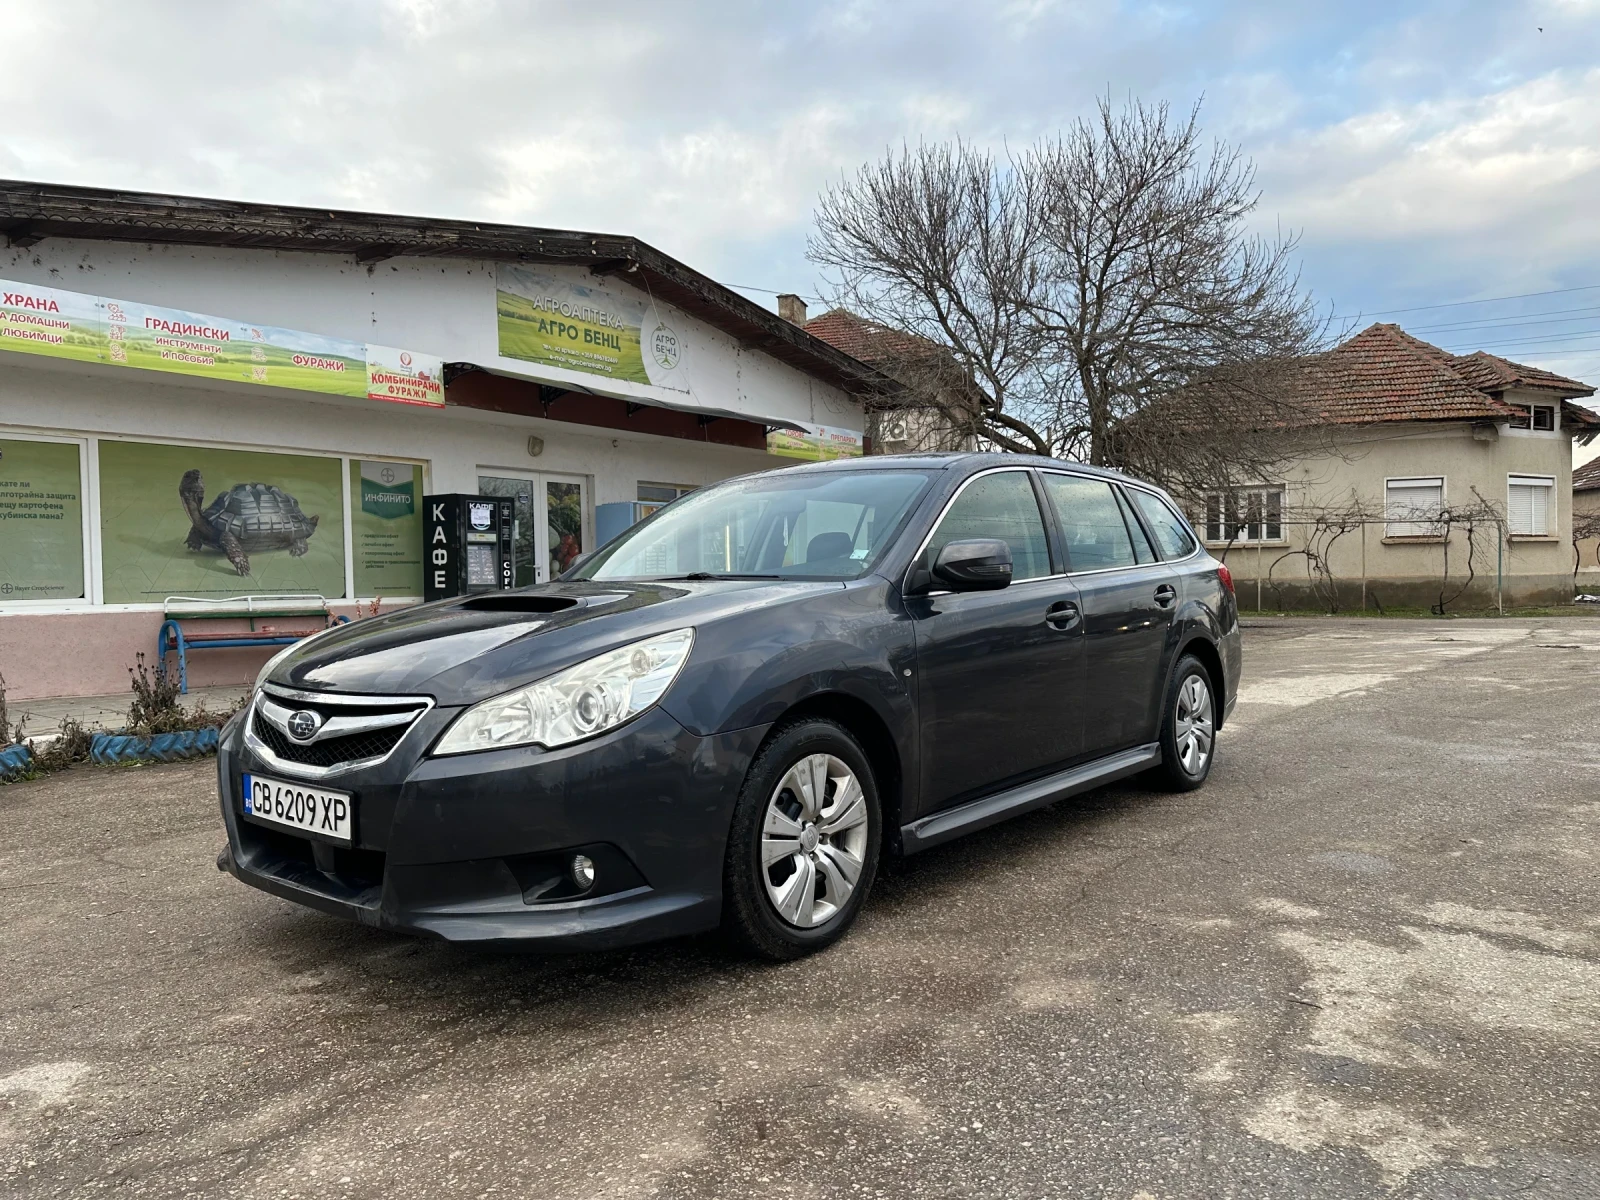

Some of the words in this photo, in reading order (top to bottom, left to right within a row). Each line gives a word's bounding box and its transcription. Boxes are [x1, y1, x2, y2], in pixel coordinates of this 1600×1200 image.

[3, 292, 60, 313] ХРАНА
[533, 295, 624, 331] АГРОАПТЕКА
[10, 313, 70, 330] ДОМАШНИ
[145, 317, 230, 341] ГРАДИНСКИ
[3, 328, 63, 344] ЛЮБИМЦИ
[538, 318, 579, 341] АГРО
[584, 328, 621, 352] БЕНЦ
[656, 334, 677, 346] АГРО
[156, 337, 222, 354] ИНСТРУМЕНТИ
[656, 344, 677, 357] БЕНЦ
[162, 351, 169, 359] И
[171, 353, 214, 365] ПОСОБИЯ
[292, 354, 345, 372] ФУРАЖИ
[371, 372, 441, 395] КОМБИНИРАНИ
[388, 385, 427, 399] ФУРАЖИ
[831, 434, 857, 444] ПРЕПАРАТИ
[0, 491, 45, 500] лготрайна
[46, 493, 76, 501] защита
[364, 493, 411, 504] ИНФИНИТО
[0, 502, 17, 510] ещу
[18, 502, 64, 511] картофена
[432, 503, 448, 588] КАФЕ
